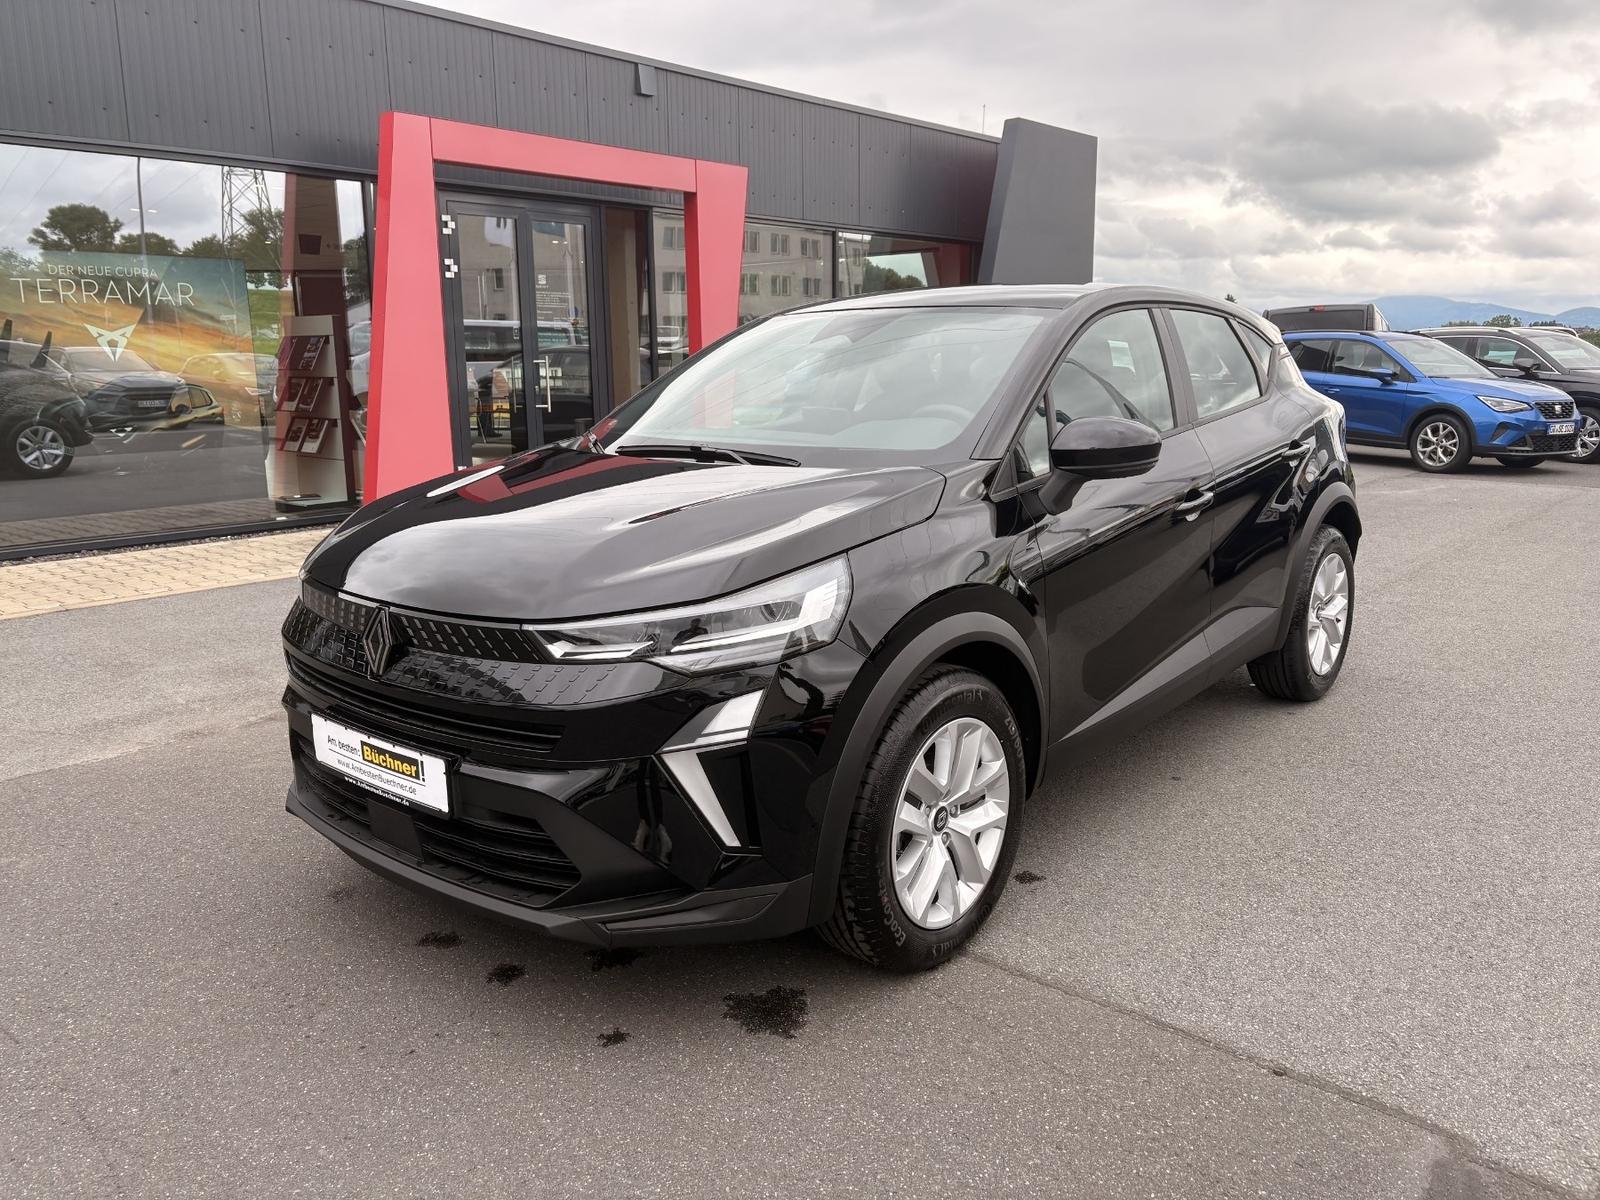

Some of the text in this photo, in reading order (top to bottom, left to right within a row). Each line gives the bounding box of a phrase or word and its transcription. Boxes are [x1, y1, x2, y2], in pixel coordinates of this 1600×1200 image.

[48, 264, 159, 278] DER NEUE CUPRA
[10, 277, 195, 307] TERRAMAR
[327, 735, 338, 747] Am
[337, 738, 361, 757] besten:
